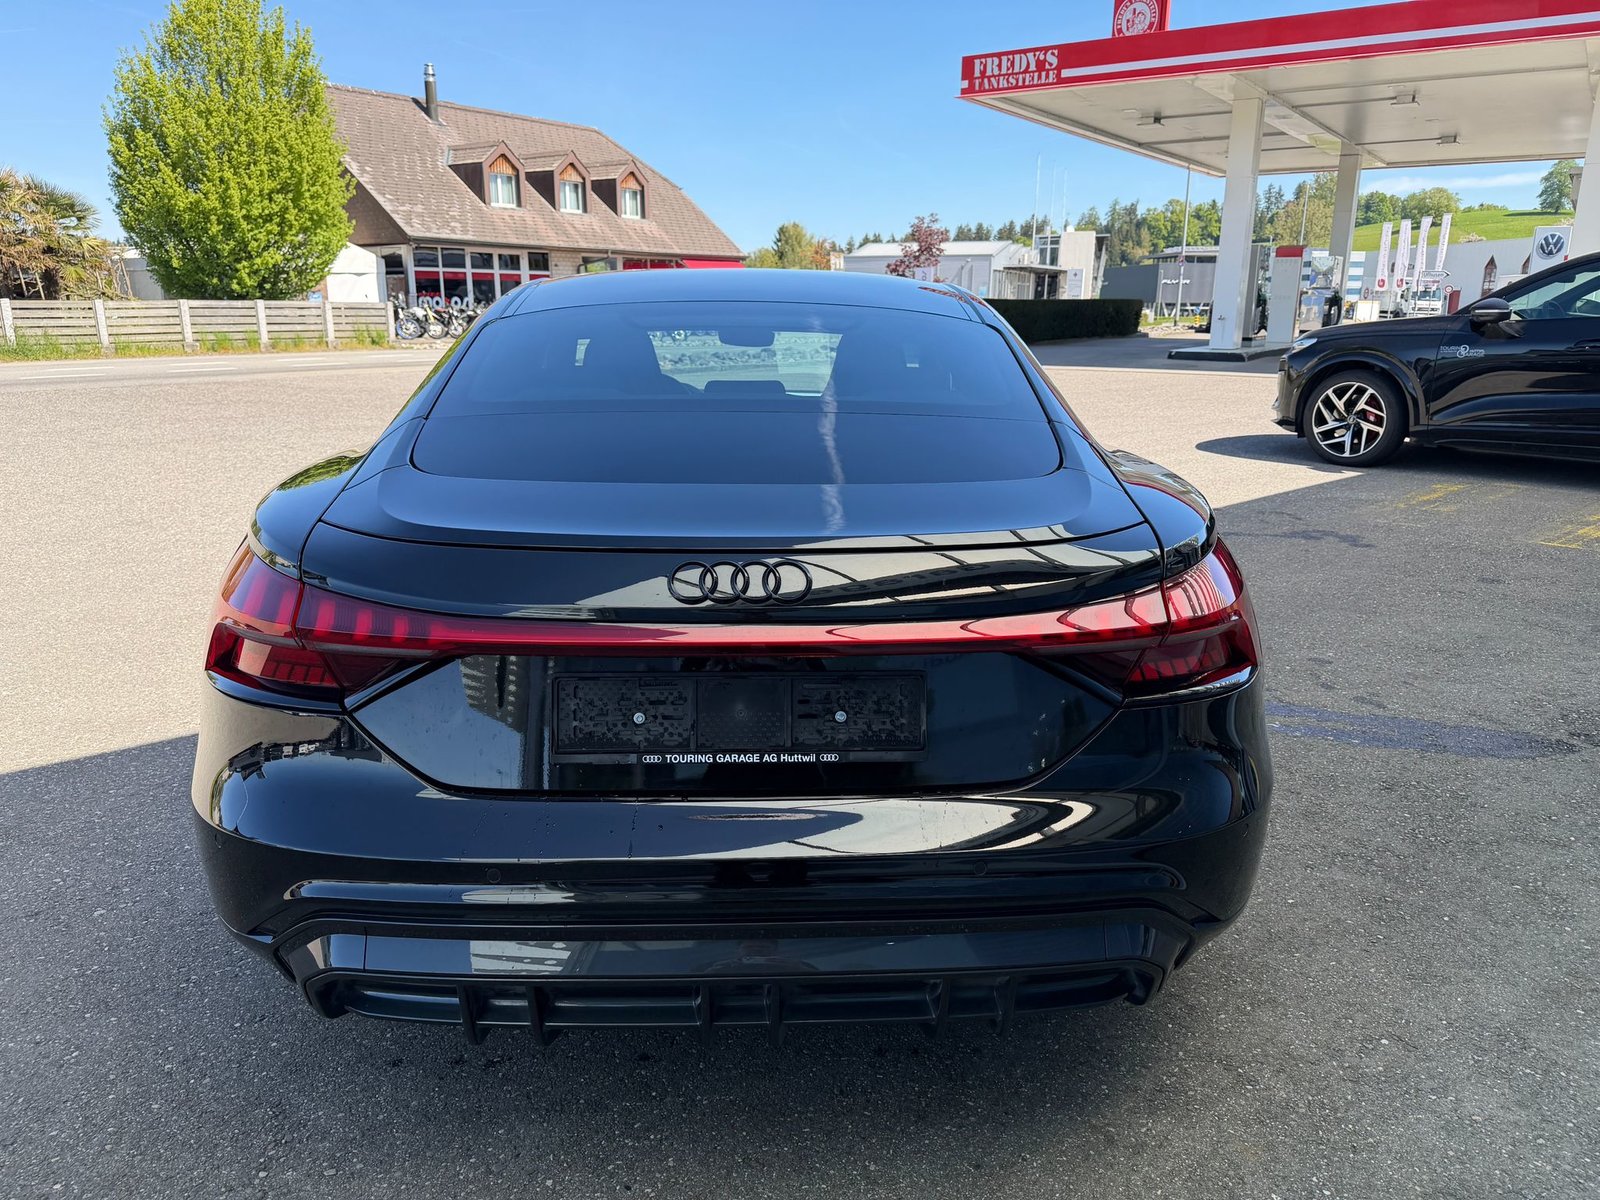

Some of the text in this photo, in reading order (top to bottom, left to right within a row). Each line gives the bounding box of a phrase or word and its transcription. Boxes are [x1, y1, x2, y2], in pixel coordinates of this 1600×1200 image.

[973, 49, 1058, 77] FREDY'S
[973, 70, 1057, 90] TANKSTELLE
[665, 753, 816, 763] TOURING GARAGE AG Huttwil
